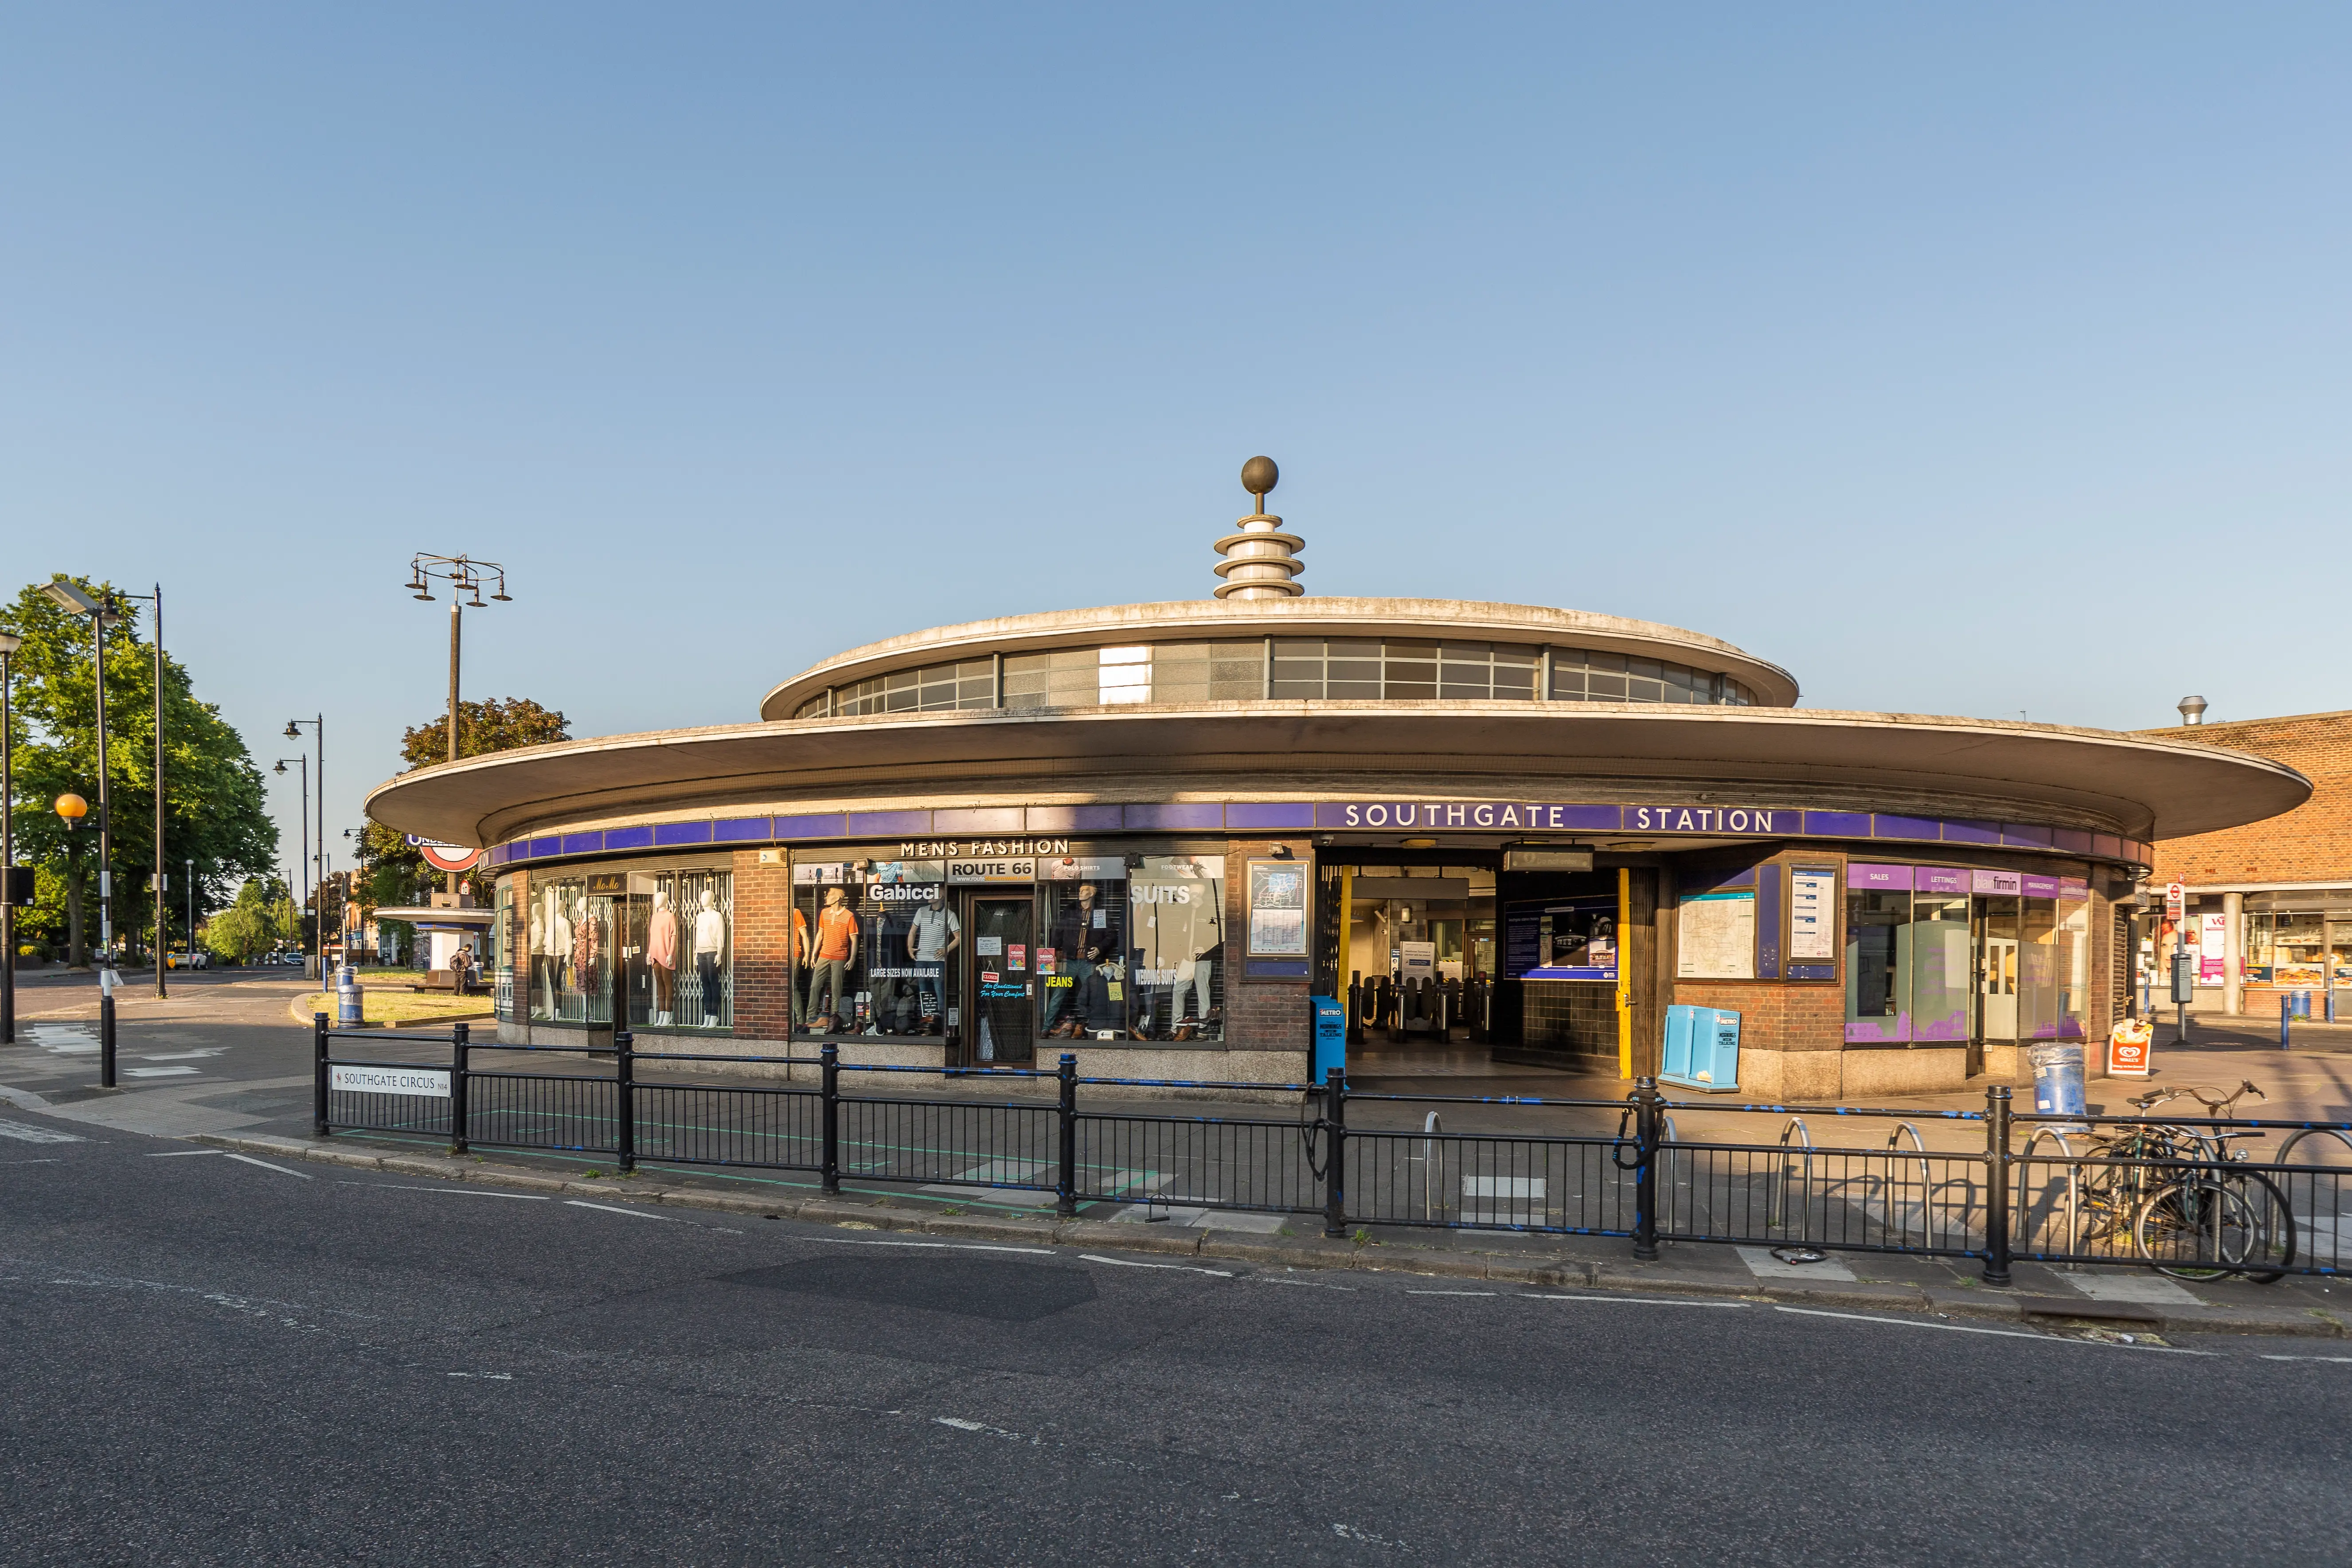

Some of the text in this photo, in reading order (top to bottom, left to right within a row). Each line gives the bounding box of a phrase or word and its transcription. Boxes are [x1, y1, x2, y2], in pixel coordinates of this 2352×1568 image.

[1346, 804, 1772, 832] SOUTHGATE STATION
[901, 839, 1069, 856] MENS FASHION
[952, 863, 1031, 875] ROUTE 66
[869, 884, 939, 900] Gabicci
[1131, 885, 1190, 904] SUITS
[871, 968, 939, 977] LARGE SIZES NOW AVAILABLE
[1135, 969, 1177, 985] WEDDING SUITS
[1046, 977, 1073, 987] JEANS
[345, 1073, 434, 1089] SOUTHGATE CIRCUS
